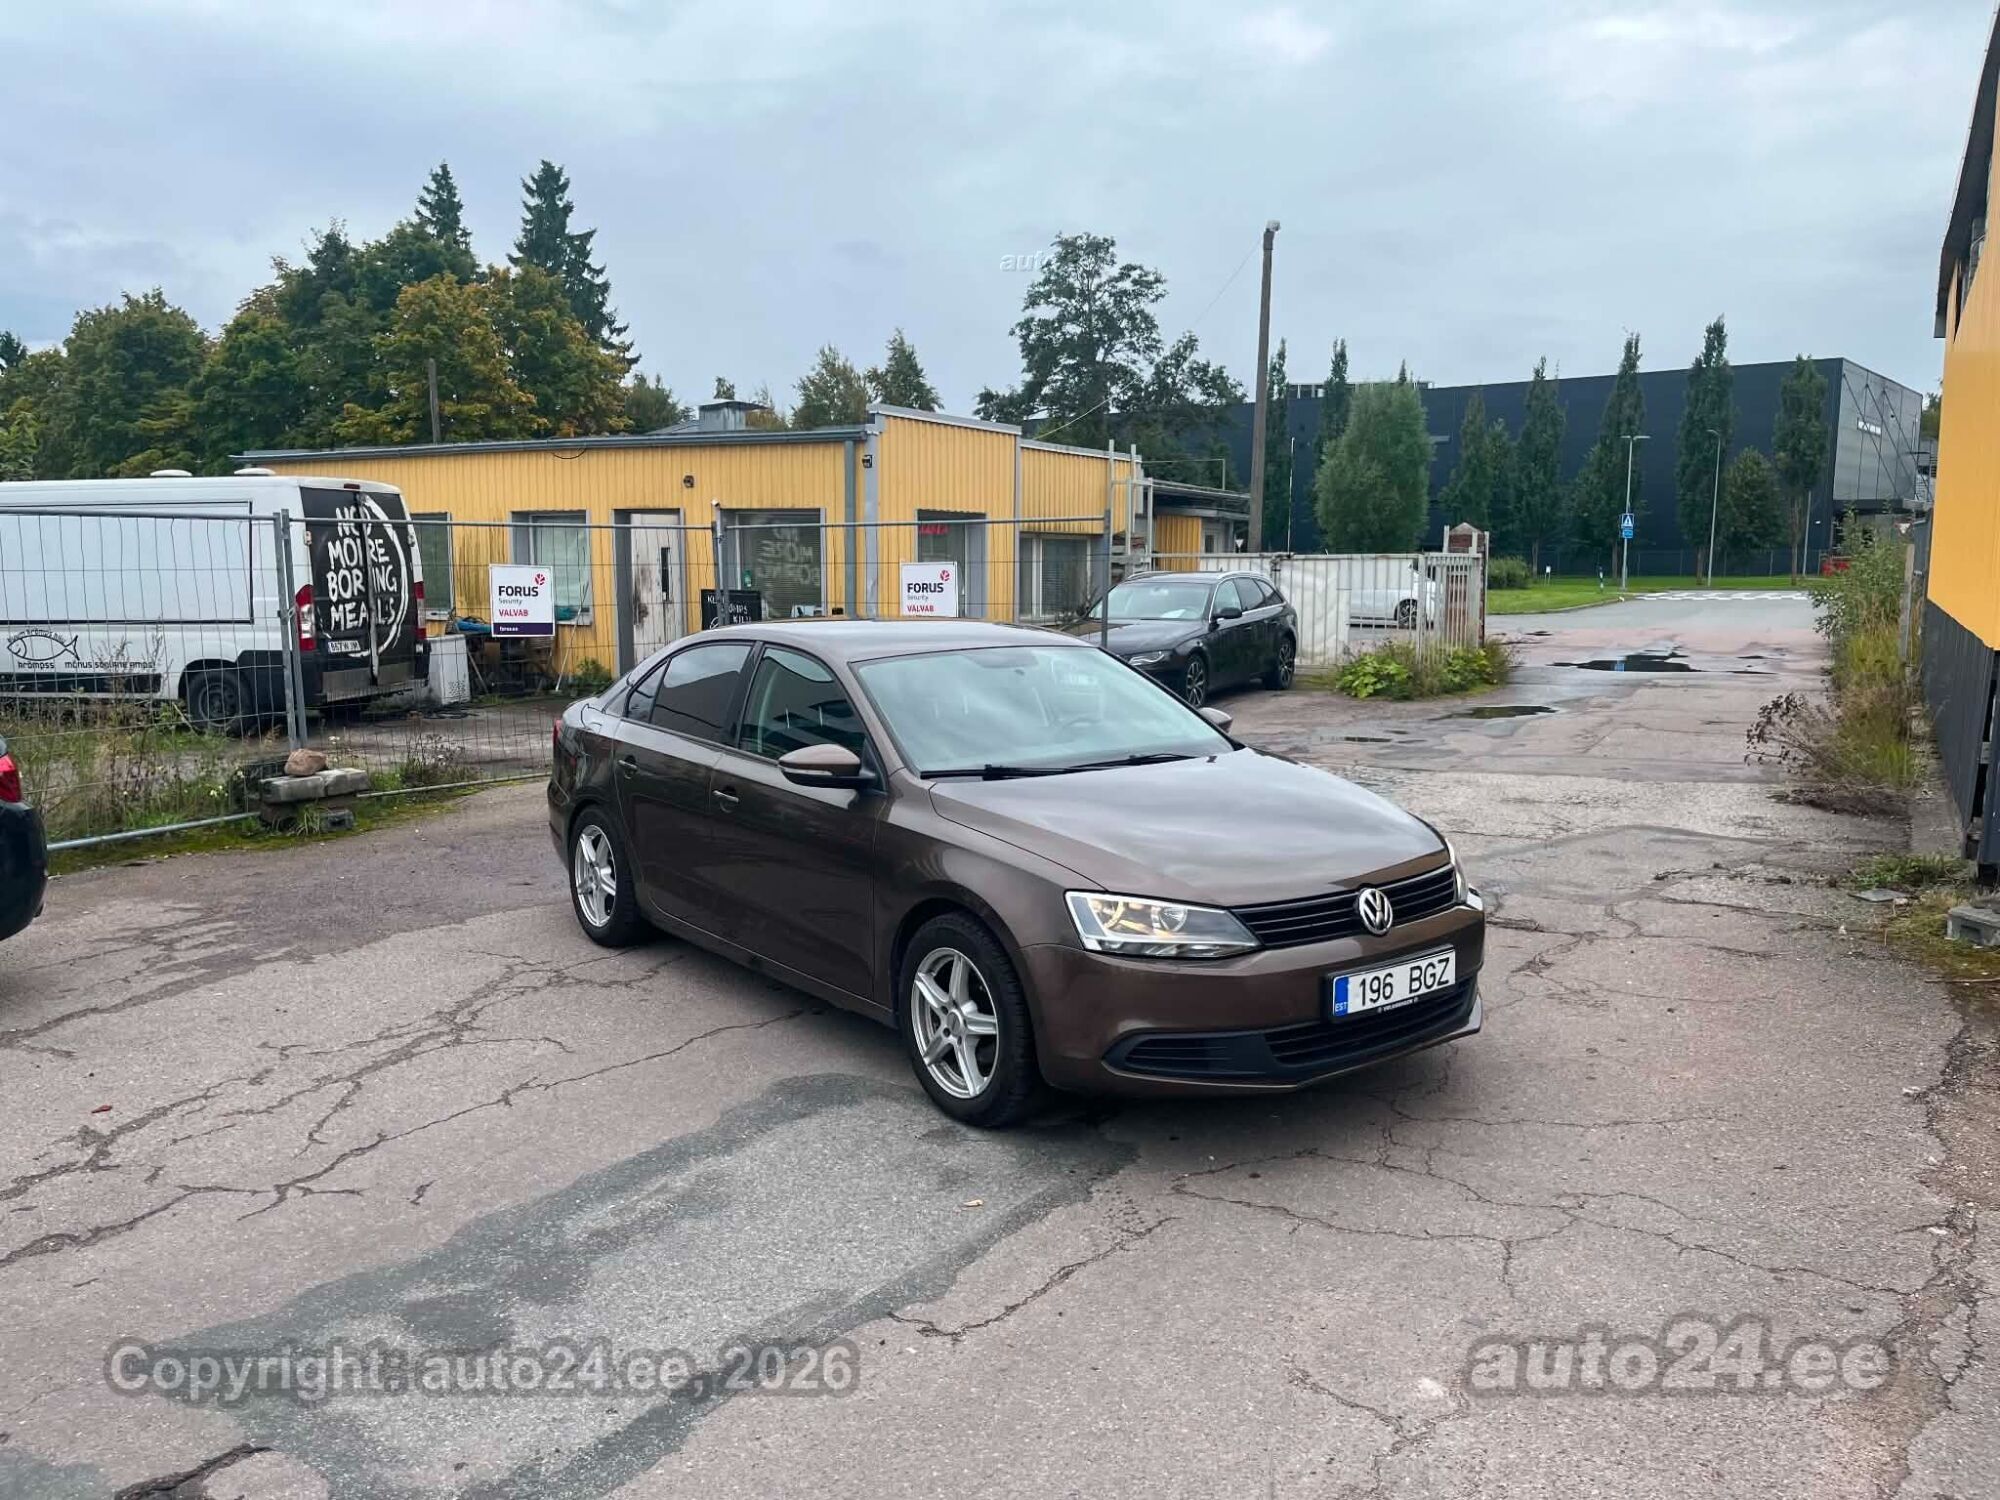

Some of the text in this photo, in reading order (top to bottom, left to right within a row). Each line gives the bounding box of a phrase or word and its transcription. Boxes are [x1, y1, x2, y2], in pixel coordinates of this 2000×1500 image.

[335, 505, 372, 537] NO
[327, 536, 390, 570] MORE
[326, 564, 397, 602] BORING
[498, 585, 539, 597] FORUS
[907, 582, 944, 593] FORUS
[331, 597, 395, 631] MEALS
[498, 608, 529, 617] VALVAB
[907, 604, 934, 613] VALVAB
[1335, 957, 1450, 1012] EST 196 BGZ
